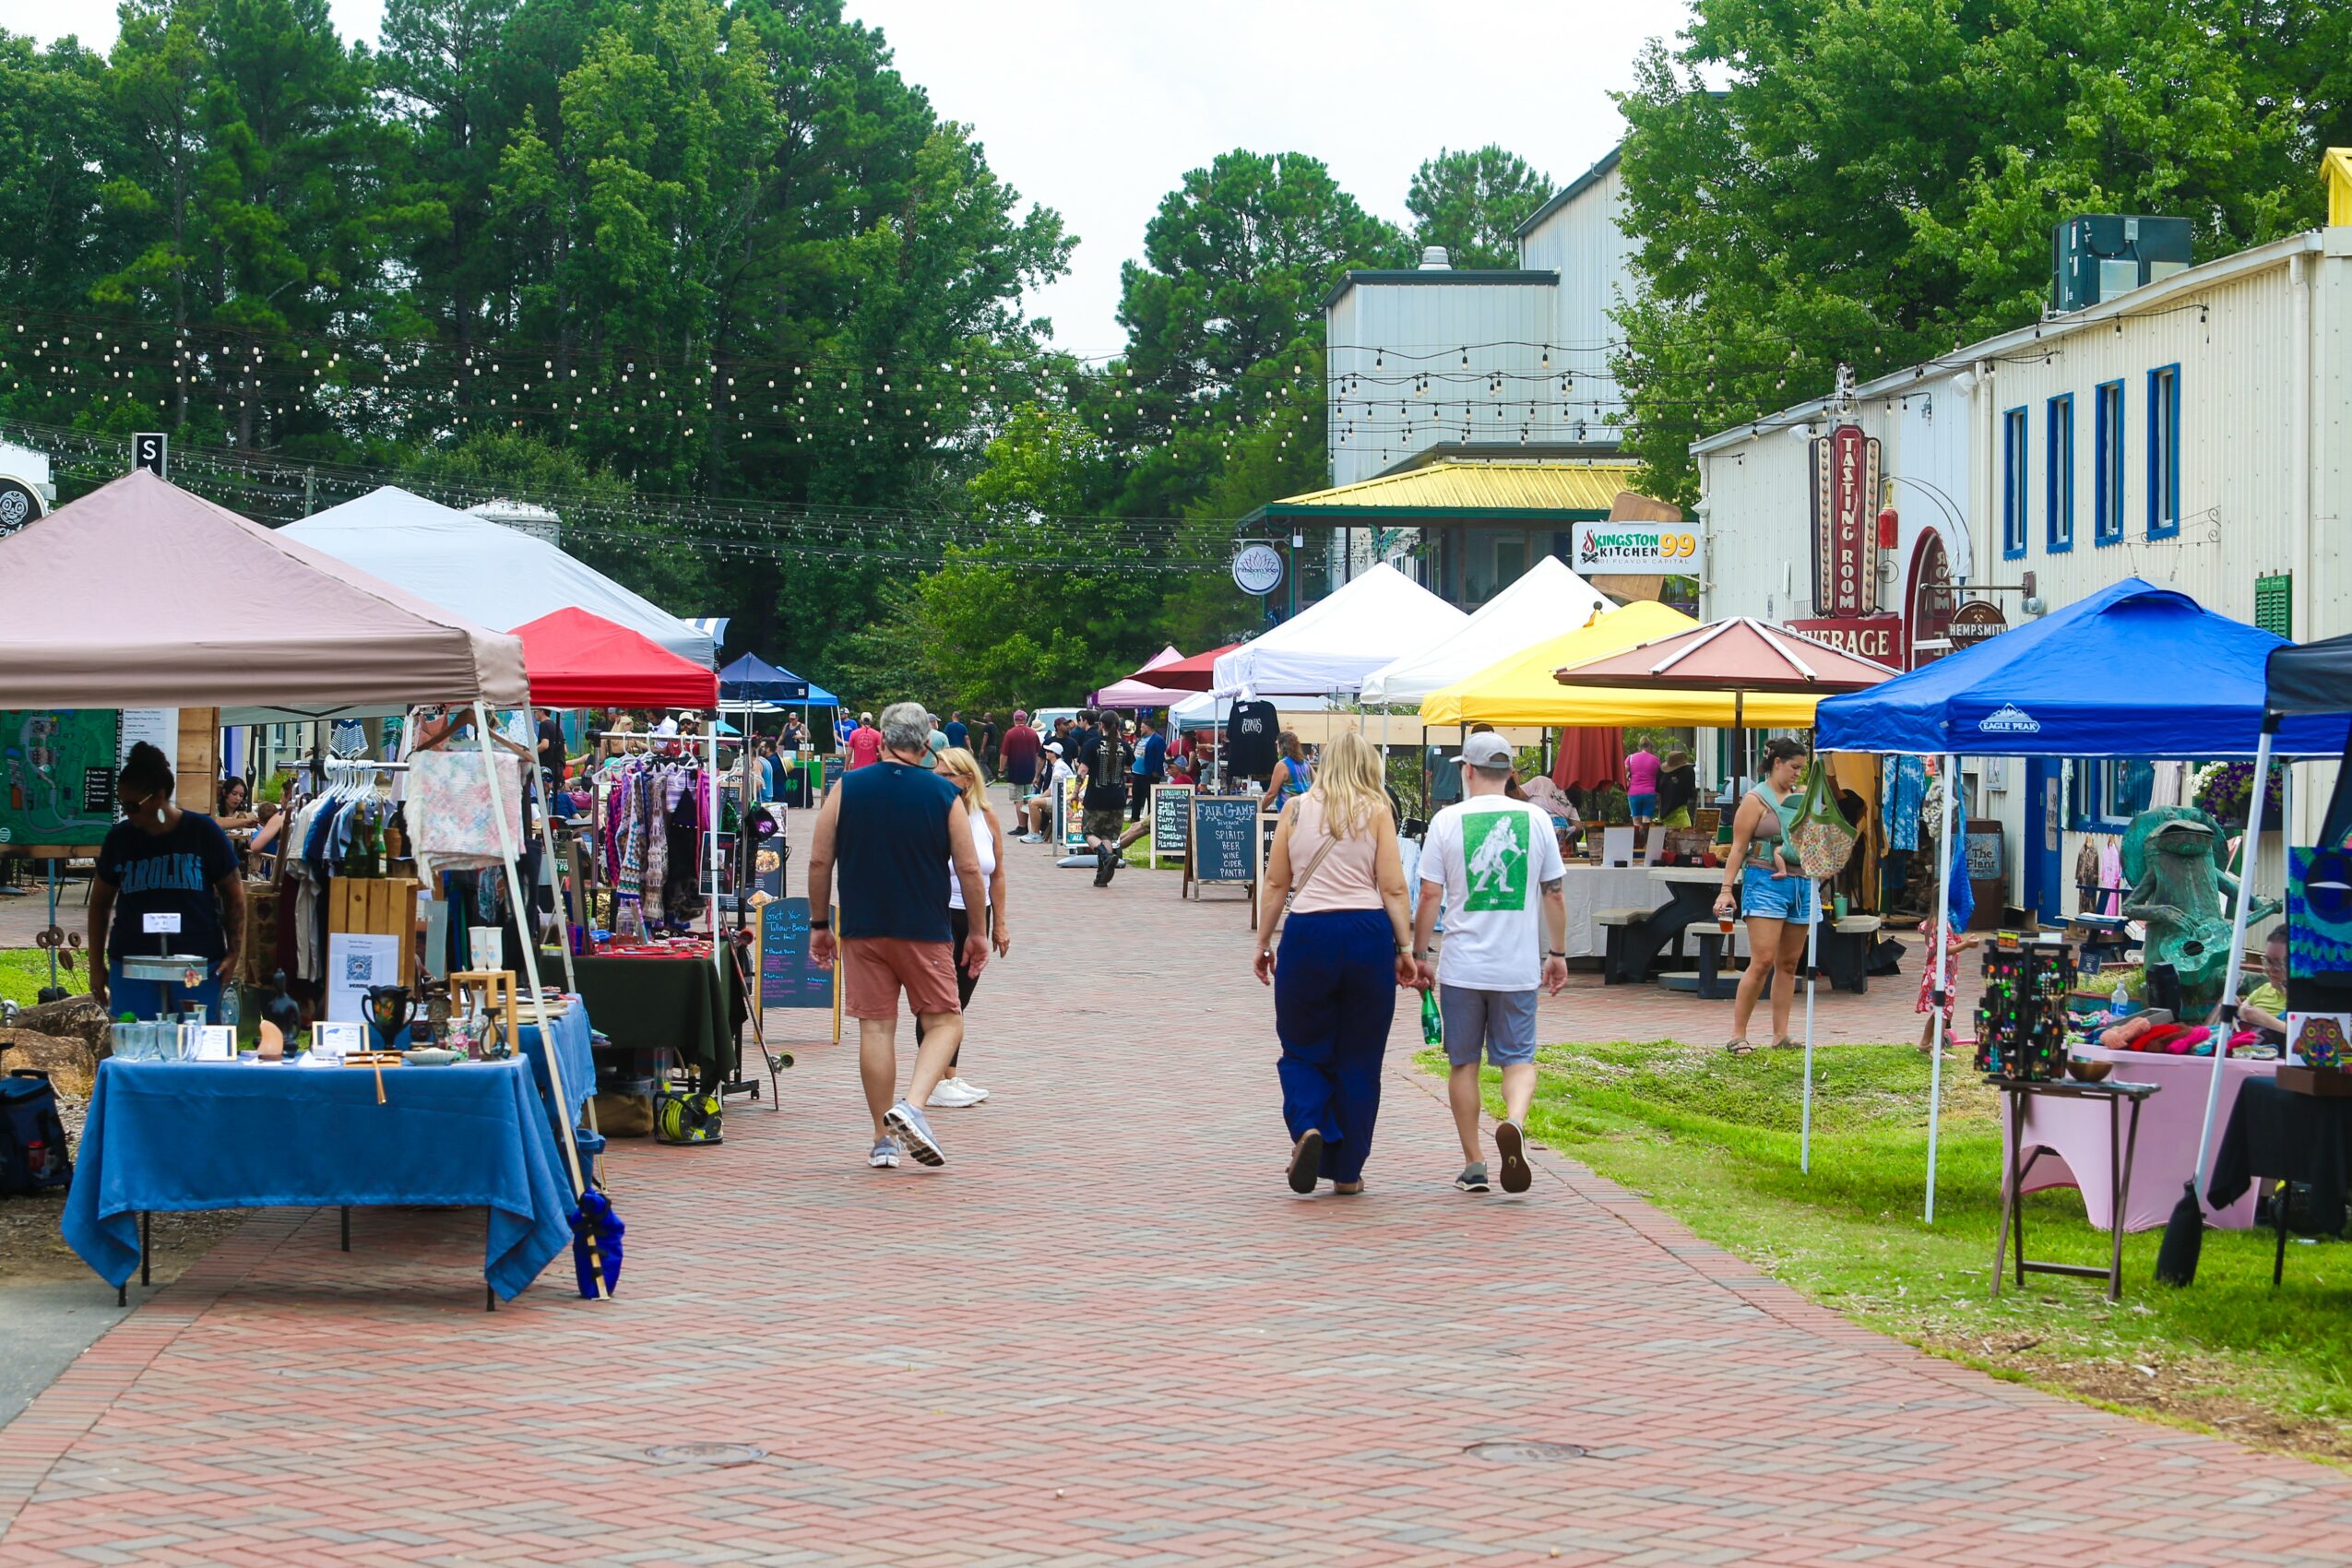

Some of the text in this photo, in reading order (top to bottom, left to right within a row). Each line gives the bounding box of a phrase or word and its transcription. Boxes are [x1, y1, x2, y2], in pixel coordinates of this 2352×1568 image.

[142, 439, 157, 460] S
[1839, 437, 1856, 609] TASTING ROOM
[1593, 533, 1695, 558] KINGSTON 99
[1599, 546, 1658, 557] KITCHEN
[1950, 624, 2006, 636] HEMPSMITH
[1983, 722, 2037, 731] EAGLE PEAK
[1158, 815, 1175, 825] Curry
[1215, 830, 1245, 840] SPIRITS
[1222, 841, 1241, 850] BEER
[1222, 851, 1240, 860] WINE
[1972, 849, 1993, 859] The
[1223, 860, 1243, 868] CIDER
[1219, 868, 1246, 878] PANTRY
